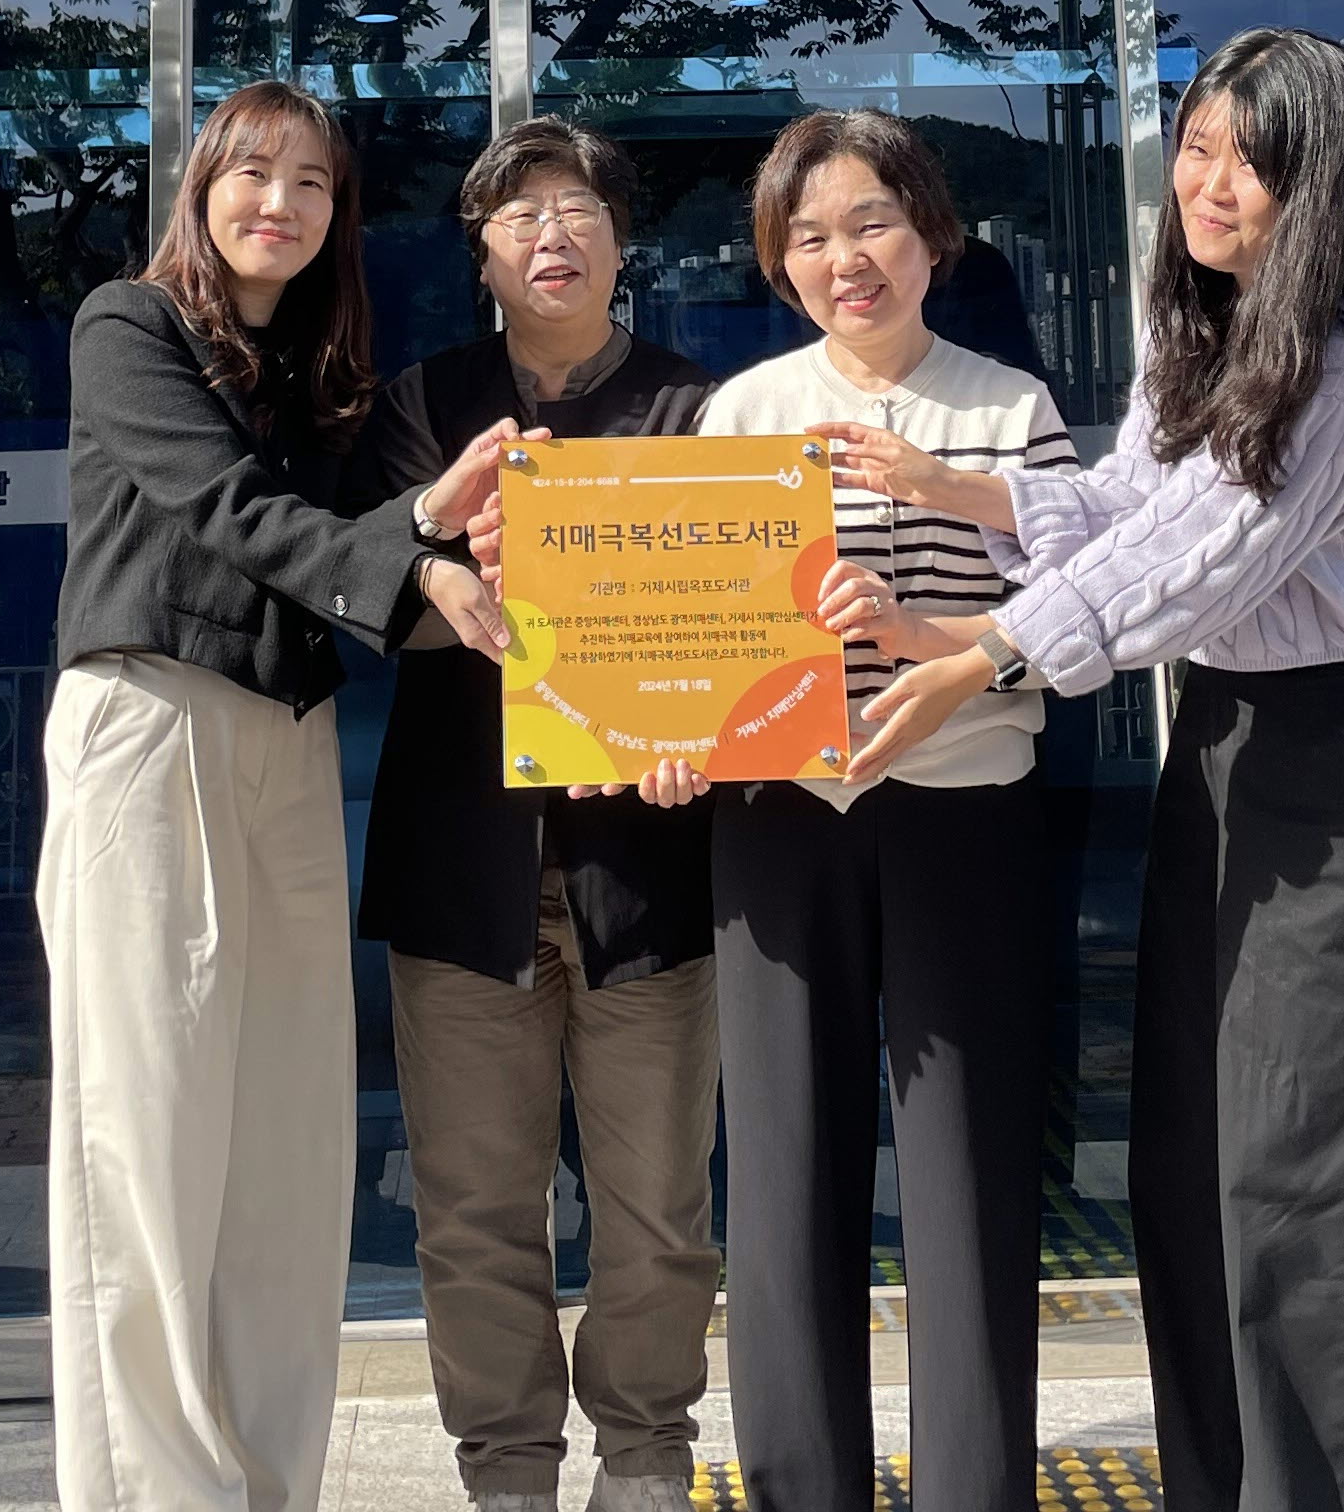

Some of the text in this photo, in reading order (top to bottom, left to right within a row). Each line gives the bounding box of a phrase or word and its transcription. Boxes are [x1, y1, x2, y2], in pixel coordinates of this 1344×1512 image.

[540, 519, 801, 553] 치매극복선도도서관
[589, 580, 626, 596] 기관명
[639, 578, 751, 595] 거제시립옥포도서관
[525, 617, 535, 629] 귀
[537, 616, 573, 628] 도서관은
[632, 614, 669, 627] 경상남도
[728, 611, 755, 624] 거제시
[579, 634, 616, 646] 추진하는
[618, 632, 663, 645] 치매교육에
[702, 630, 737, 643] 치매극복
[740, 629, 767, 642] 활동에
[559, 652, 578, 664] 적극
[741, 646, 789, 660] 지정합니다.
[637, 679, 671, 692] 2024년
[673, 679, 689, 692] 7월
[534, 679, 591, 729] 중앙치매센터
[606, 727, 648, 751] 경상남도
[734, 715, 768, 738] 거제시
